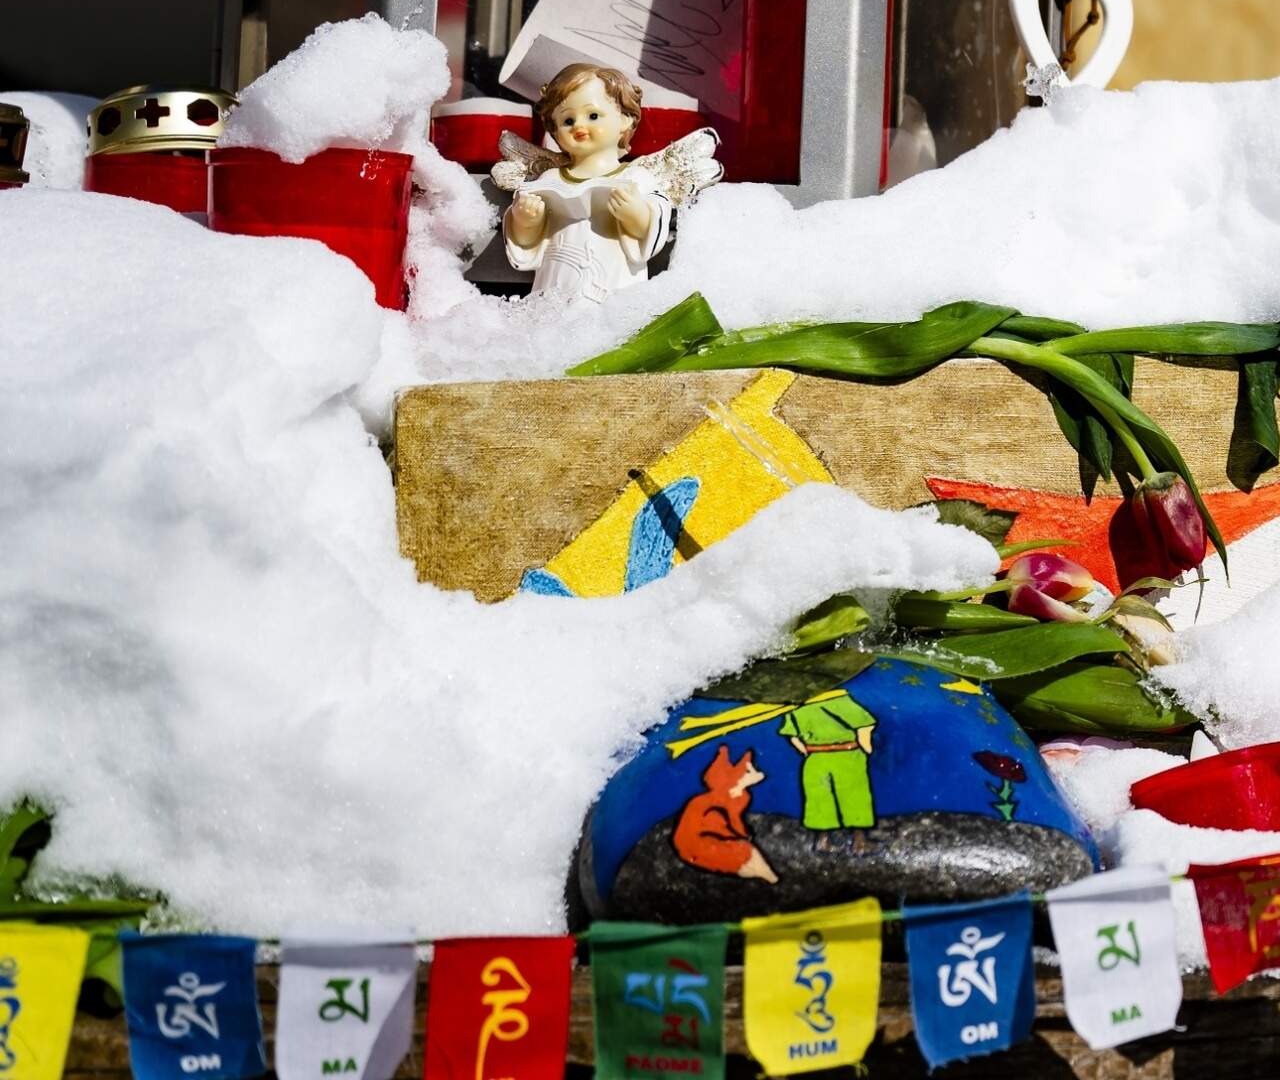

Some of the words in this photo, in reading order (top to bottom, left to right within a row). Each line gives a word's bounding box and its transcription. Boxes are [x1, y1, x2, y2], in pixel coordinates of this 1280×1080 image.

[1111, 1003, 1144, 1025] MA
[960, 1021, 1000, 1045] OM
[789, 1039, 838, 1060] HUM
[180, 1053, 222, 1074] OM
[322, 1056, 358, 1076] MA
[625, 1054, 704, 1077] PADME
